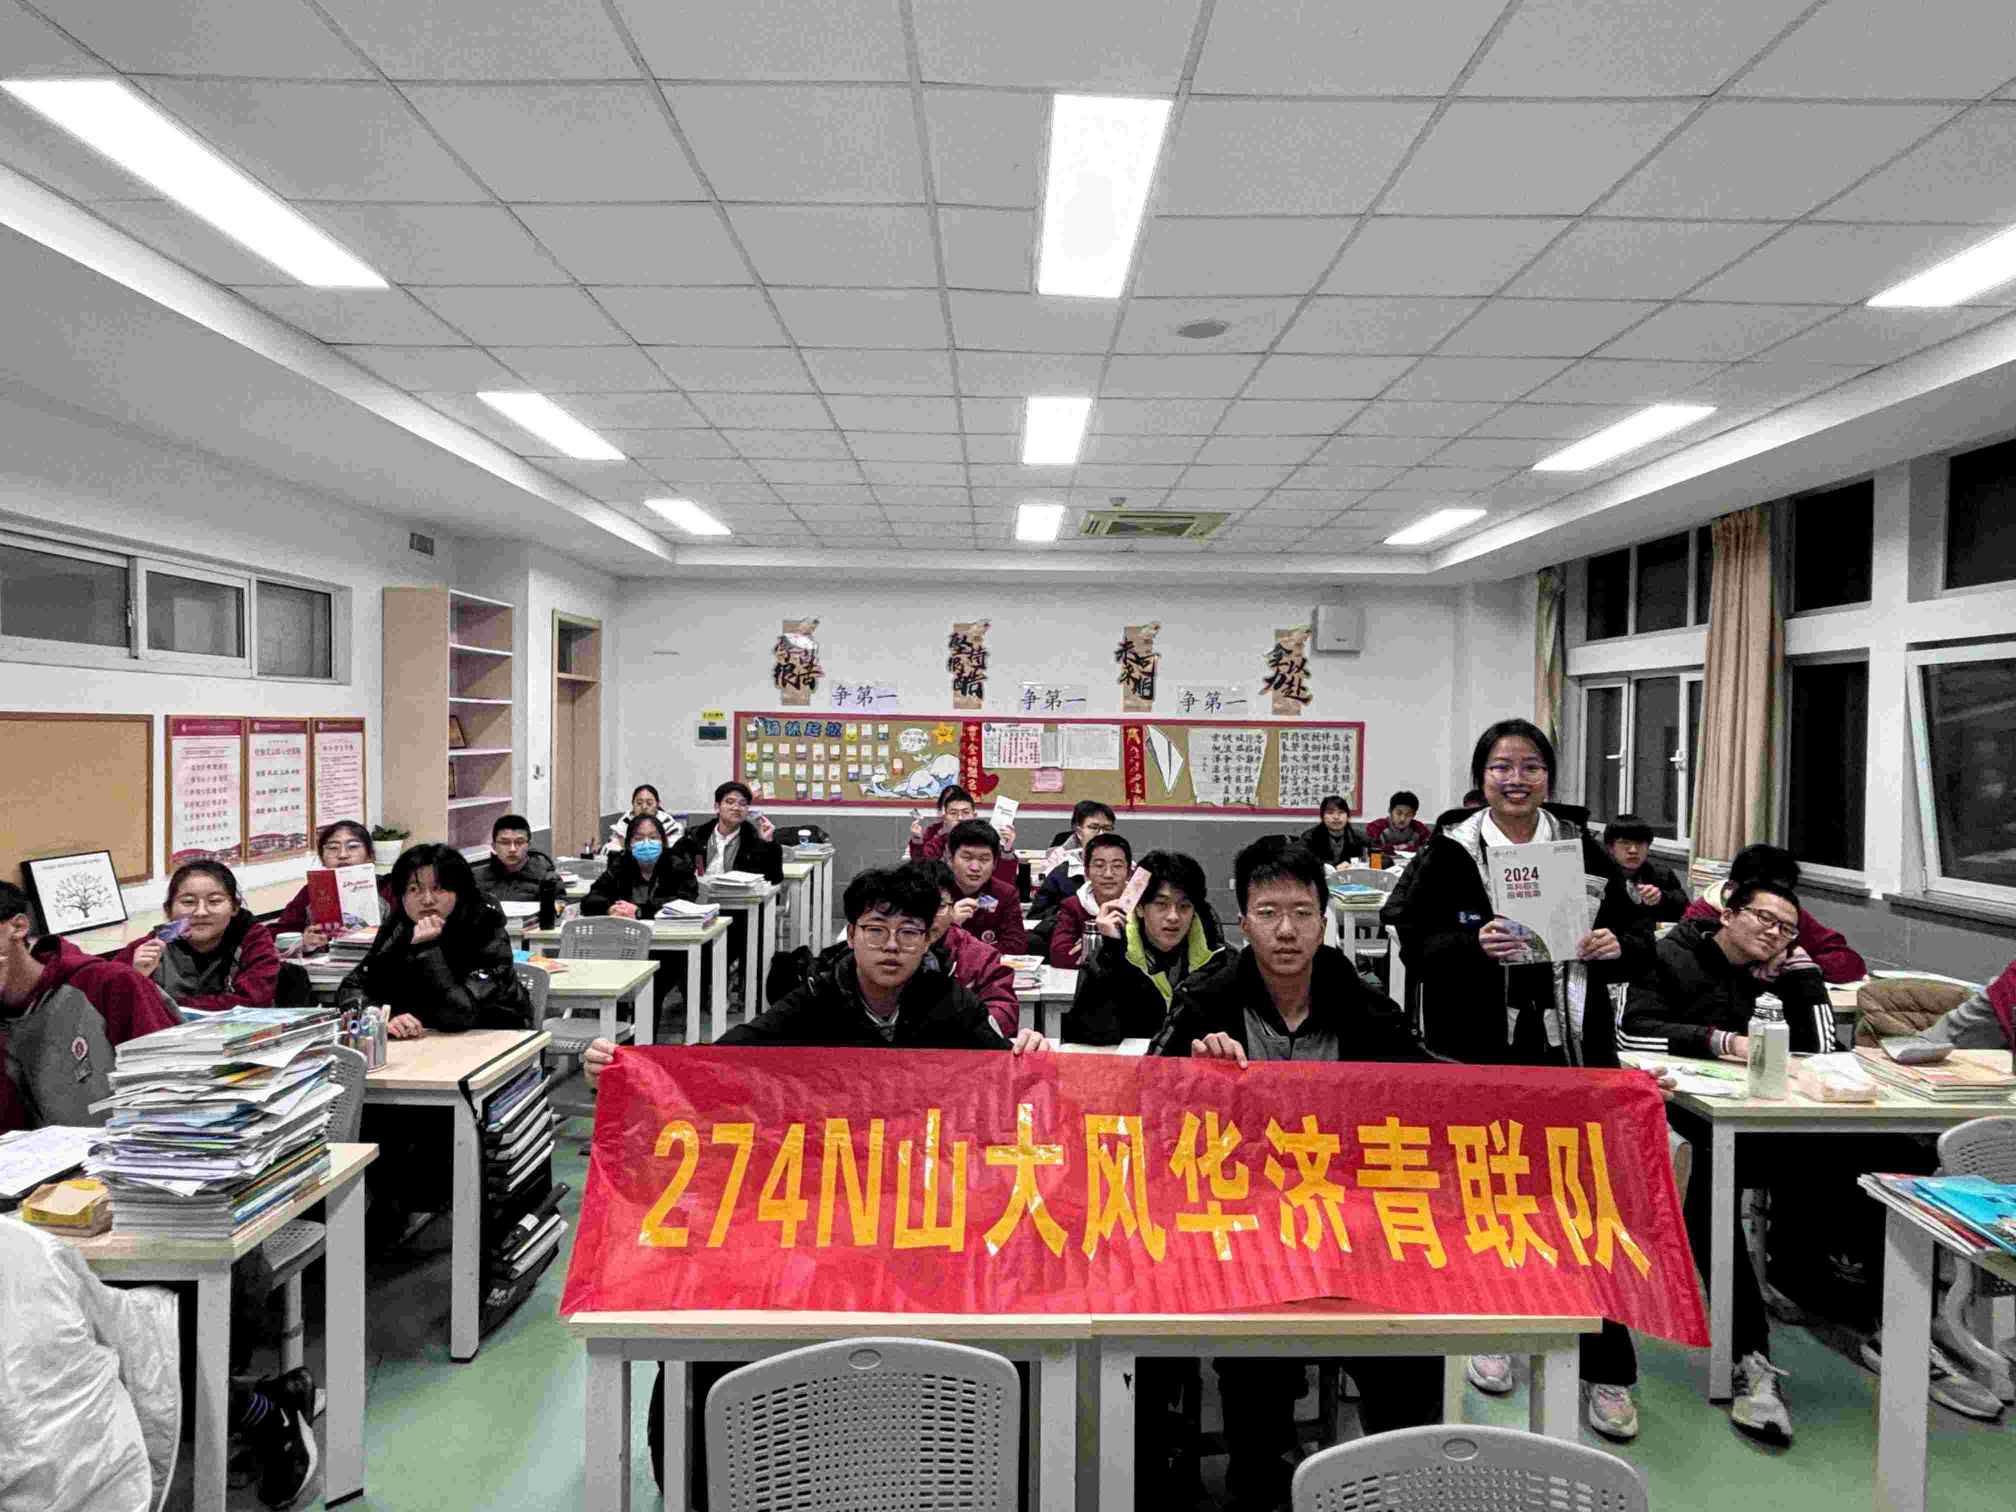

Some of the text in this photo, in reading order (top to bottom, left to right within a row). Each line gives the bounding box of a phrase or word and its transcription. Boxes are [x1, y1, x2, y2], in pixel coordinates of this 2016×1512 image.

[831, 684, 898, 706] 争第一
[1021, 688, 1087, 710] 争第一
[1179, 690, 1247, 713] 争第一
[1504, 866, 1540, 882] 2024
[637, 1102, 1653, 1281] 274N山大风华济青联队
